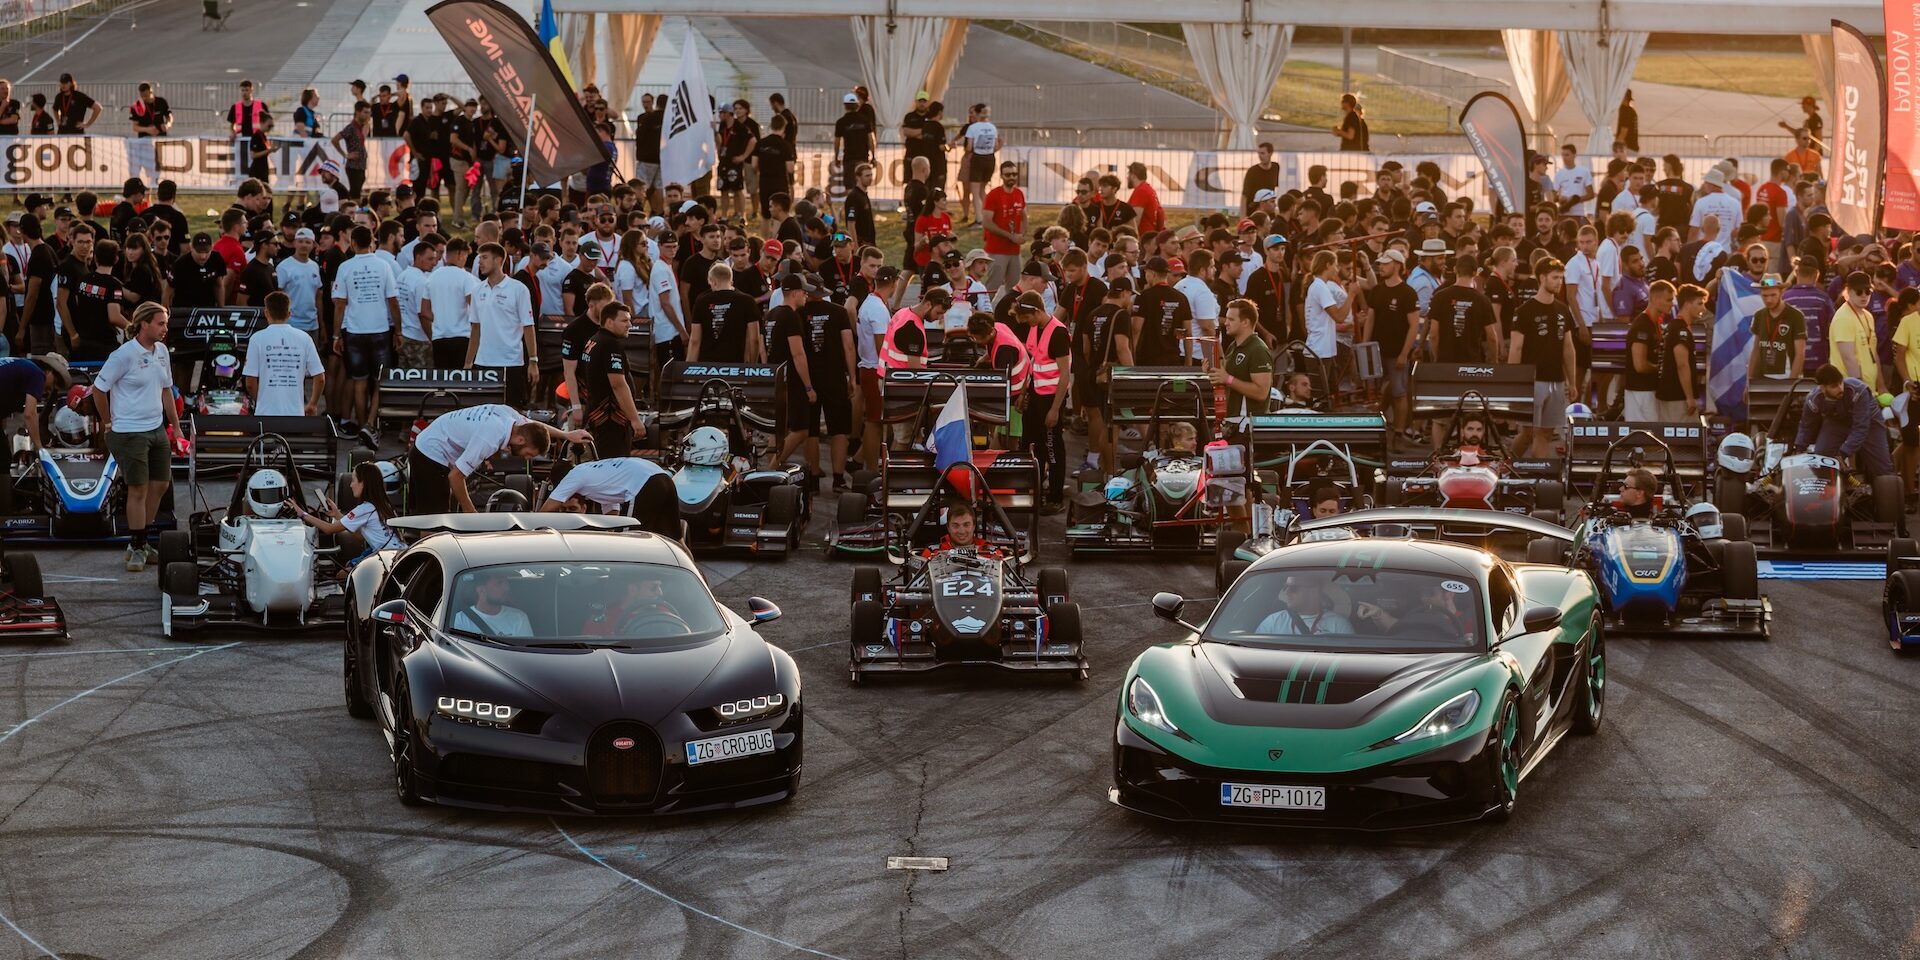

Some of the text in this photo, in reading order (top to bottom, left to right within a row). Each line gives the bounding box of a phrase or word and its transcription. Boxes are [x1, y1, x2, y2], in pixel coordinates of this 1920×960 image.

[4, 135, 107, 184] god.
[197, 314, 225, 326] AVL
[697, 366, 775, 377] RACE-ING.
[1458, 366, 1495, 374] PEAK
[1256, 416, 1379, 424] BME MOTORSPORT
[943, 580, 994, 597] E24
[1446, 583, 1463, 591] 655
[697, 742, 714, 759] ZG
[1233, 787, 1251, 803] ZG
